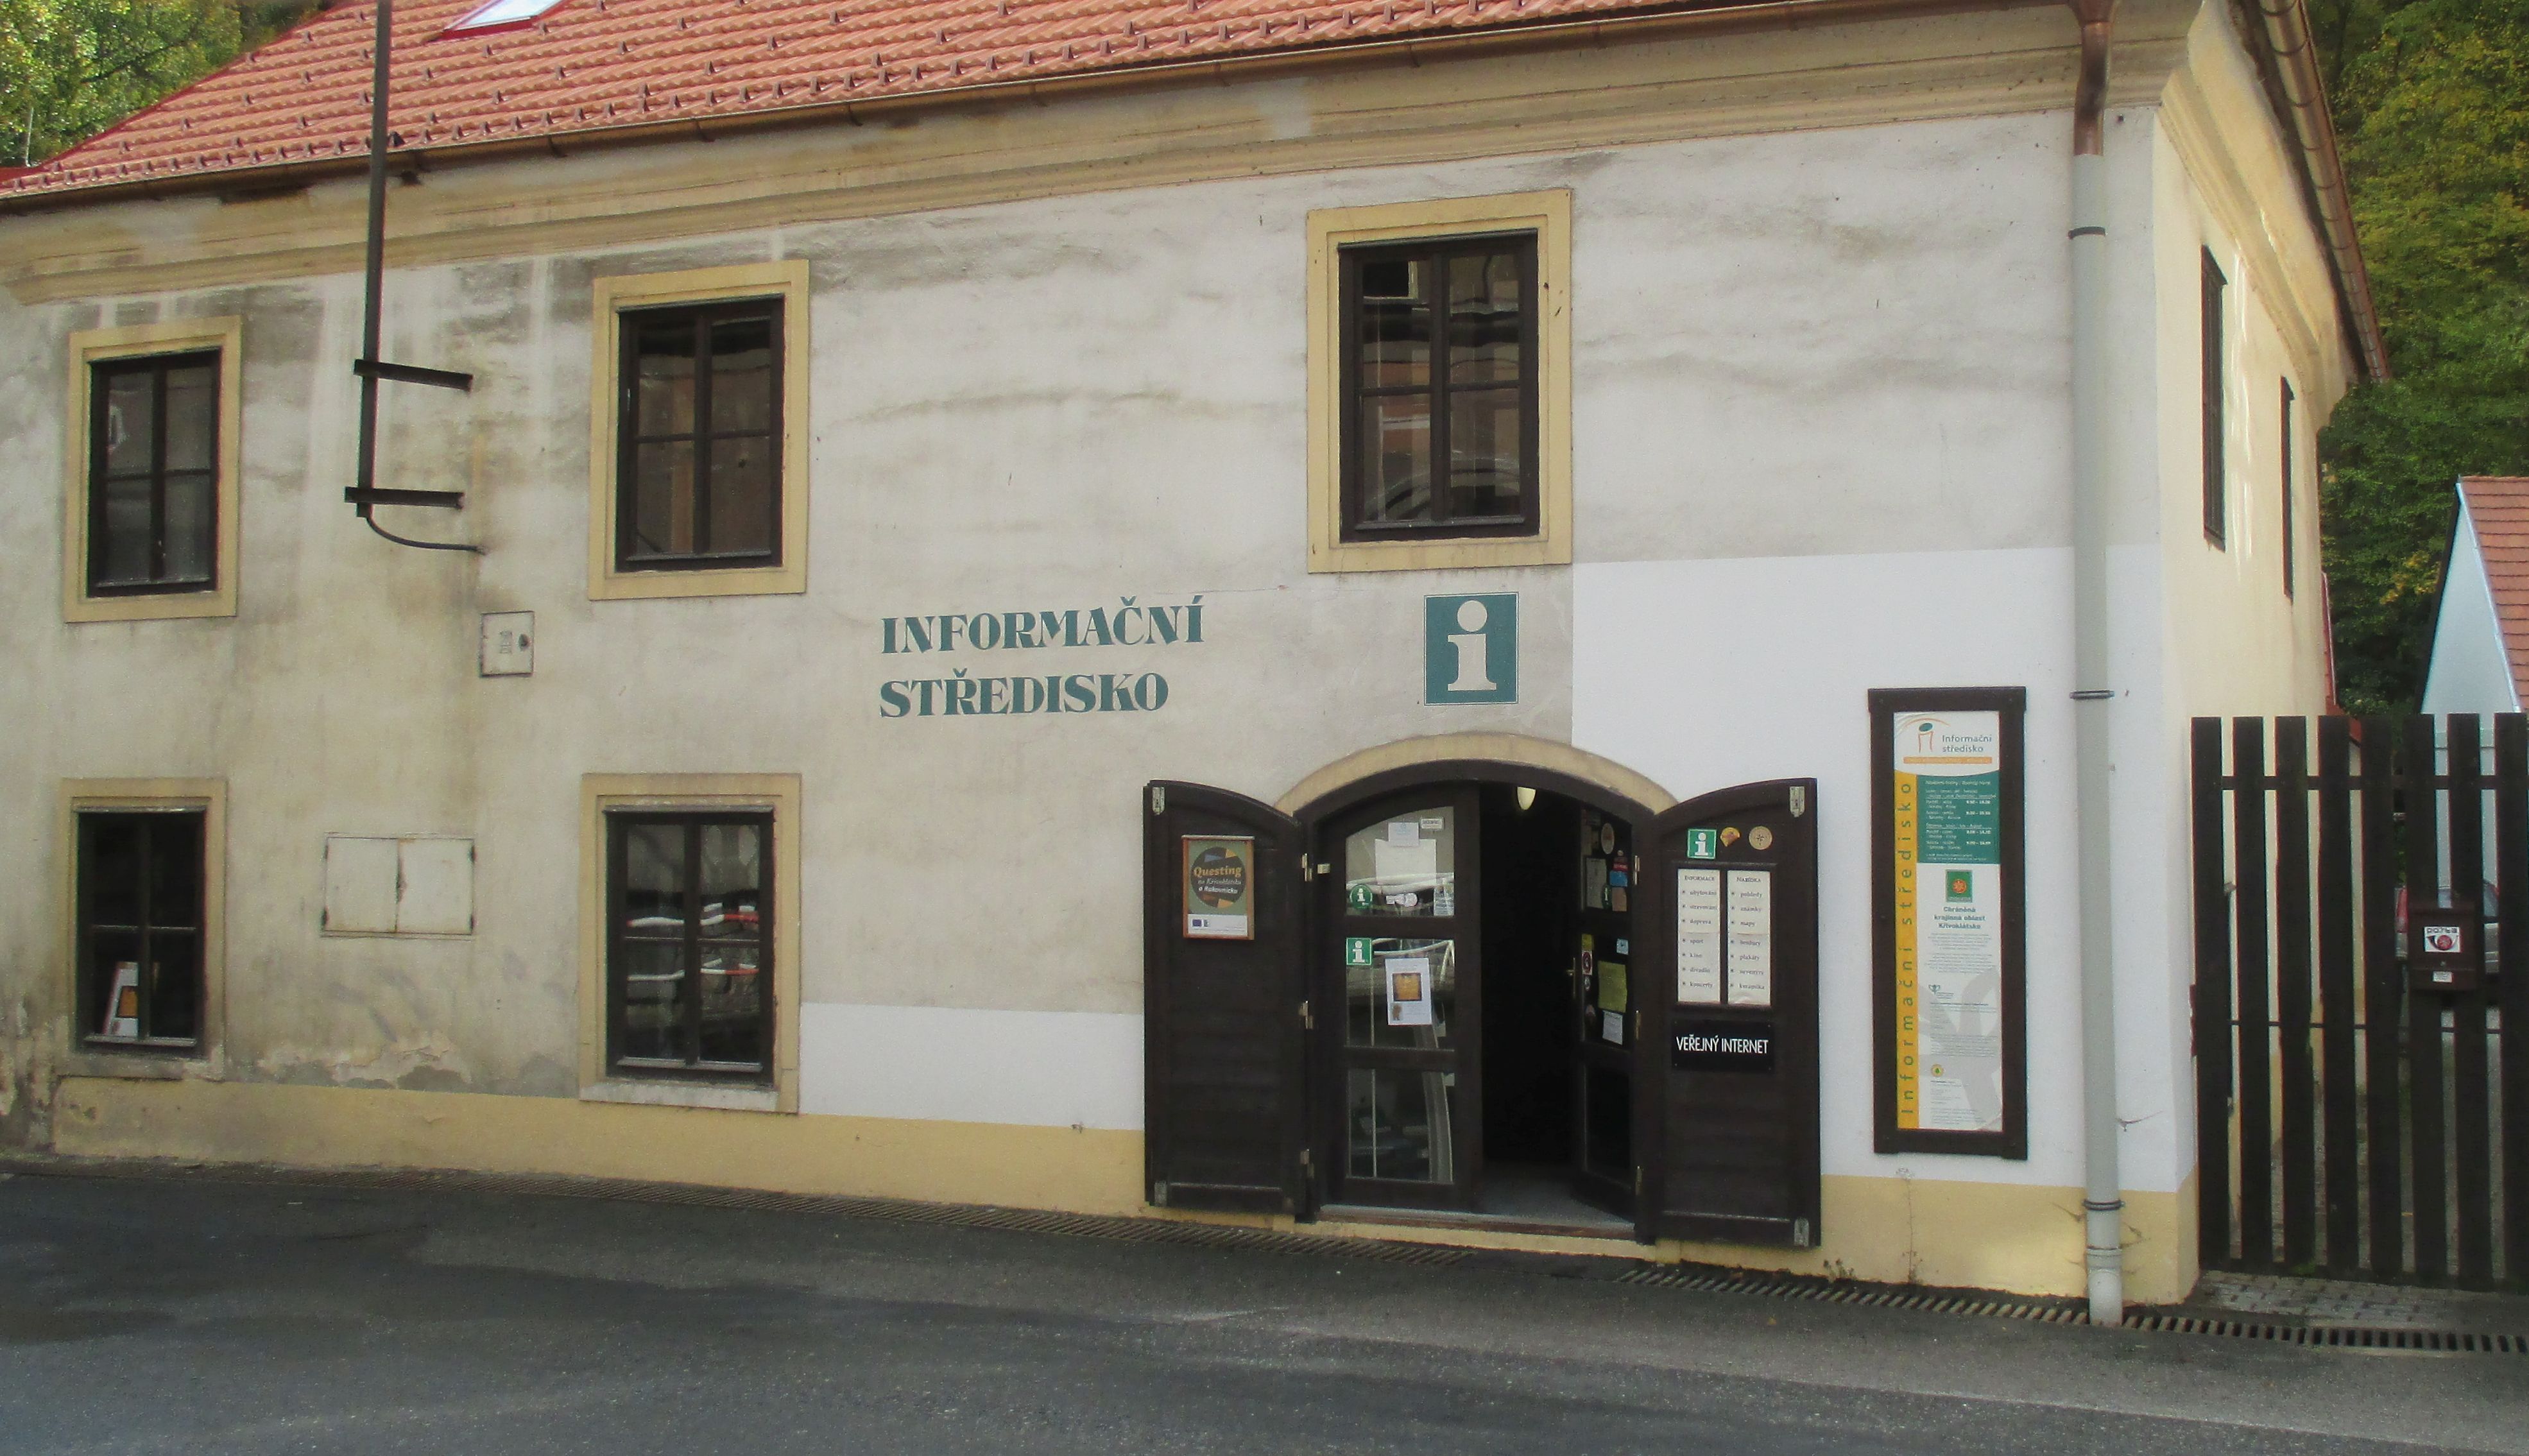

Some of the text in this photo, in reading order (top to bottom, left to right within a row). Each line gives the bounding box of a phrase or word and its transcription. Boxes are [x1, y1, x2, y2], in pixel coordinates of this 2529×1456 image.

[881, 595, 1204, 654] INFORMAČNÍ
[880, 668, 1169, 718] STŘEDISKO
[1942, 734, 1992, 742] Informační
[1942, 744, 1984, 753] středisko
[1194, 865, 1242, 878] Questing
[1897, 784, 1914, 1114] Informační středisko
[1676, 1034, 1769, 1054] VEŘEJNÝ INTERNET
